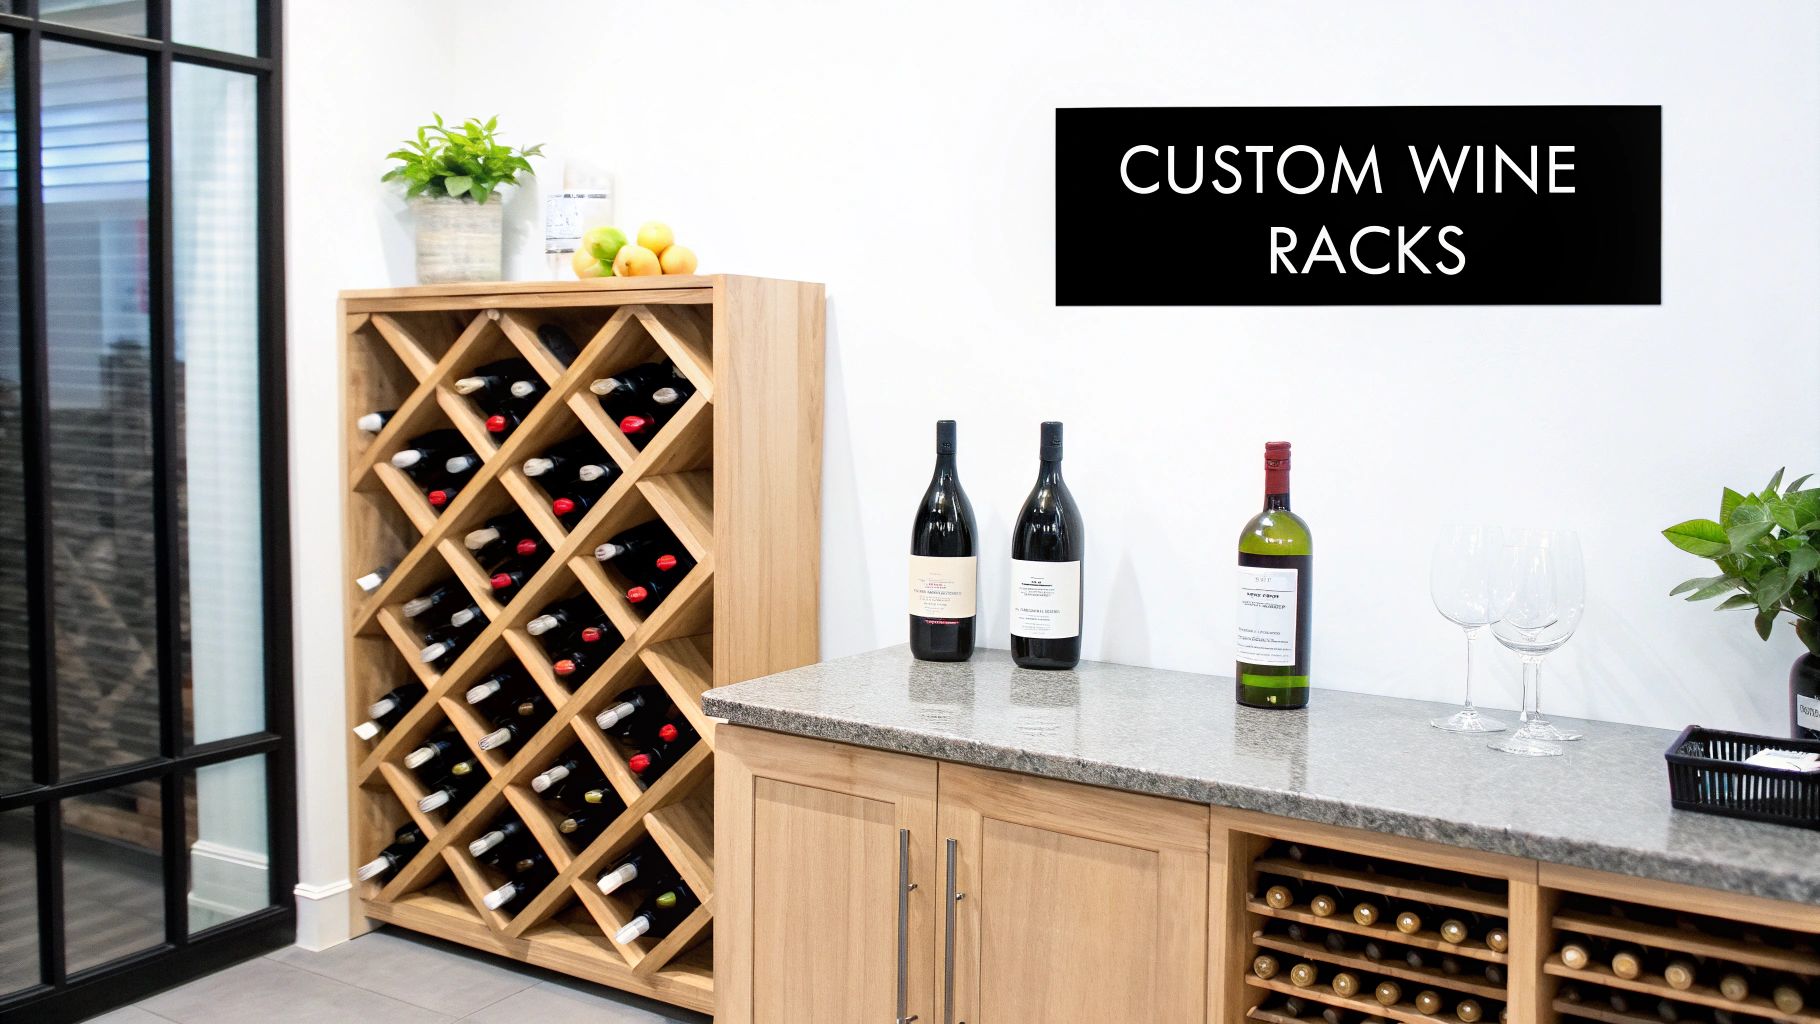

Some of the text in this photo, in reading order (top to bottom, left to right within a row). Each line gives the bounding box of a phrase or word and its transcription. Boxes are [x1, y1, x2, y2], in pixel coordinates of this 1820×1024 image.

[1121, 145, 1575, 194] CUSTOM WINE
[1271, 225, 1465, 275] RACKS
